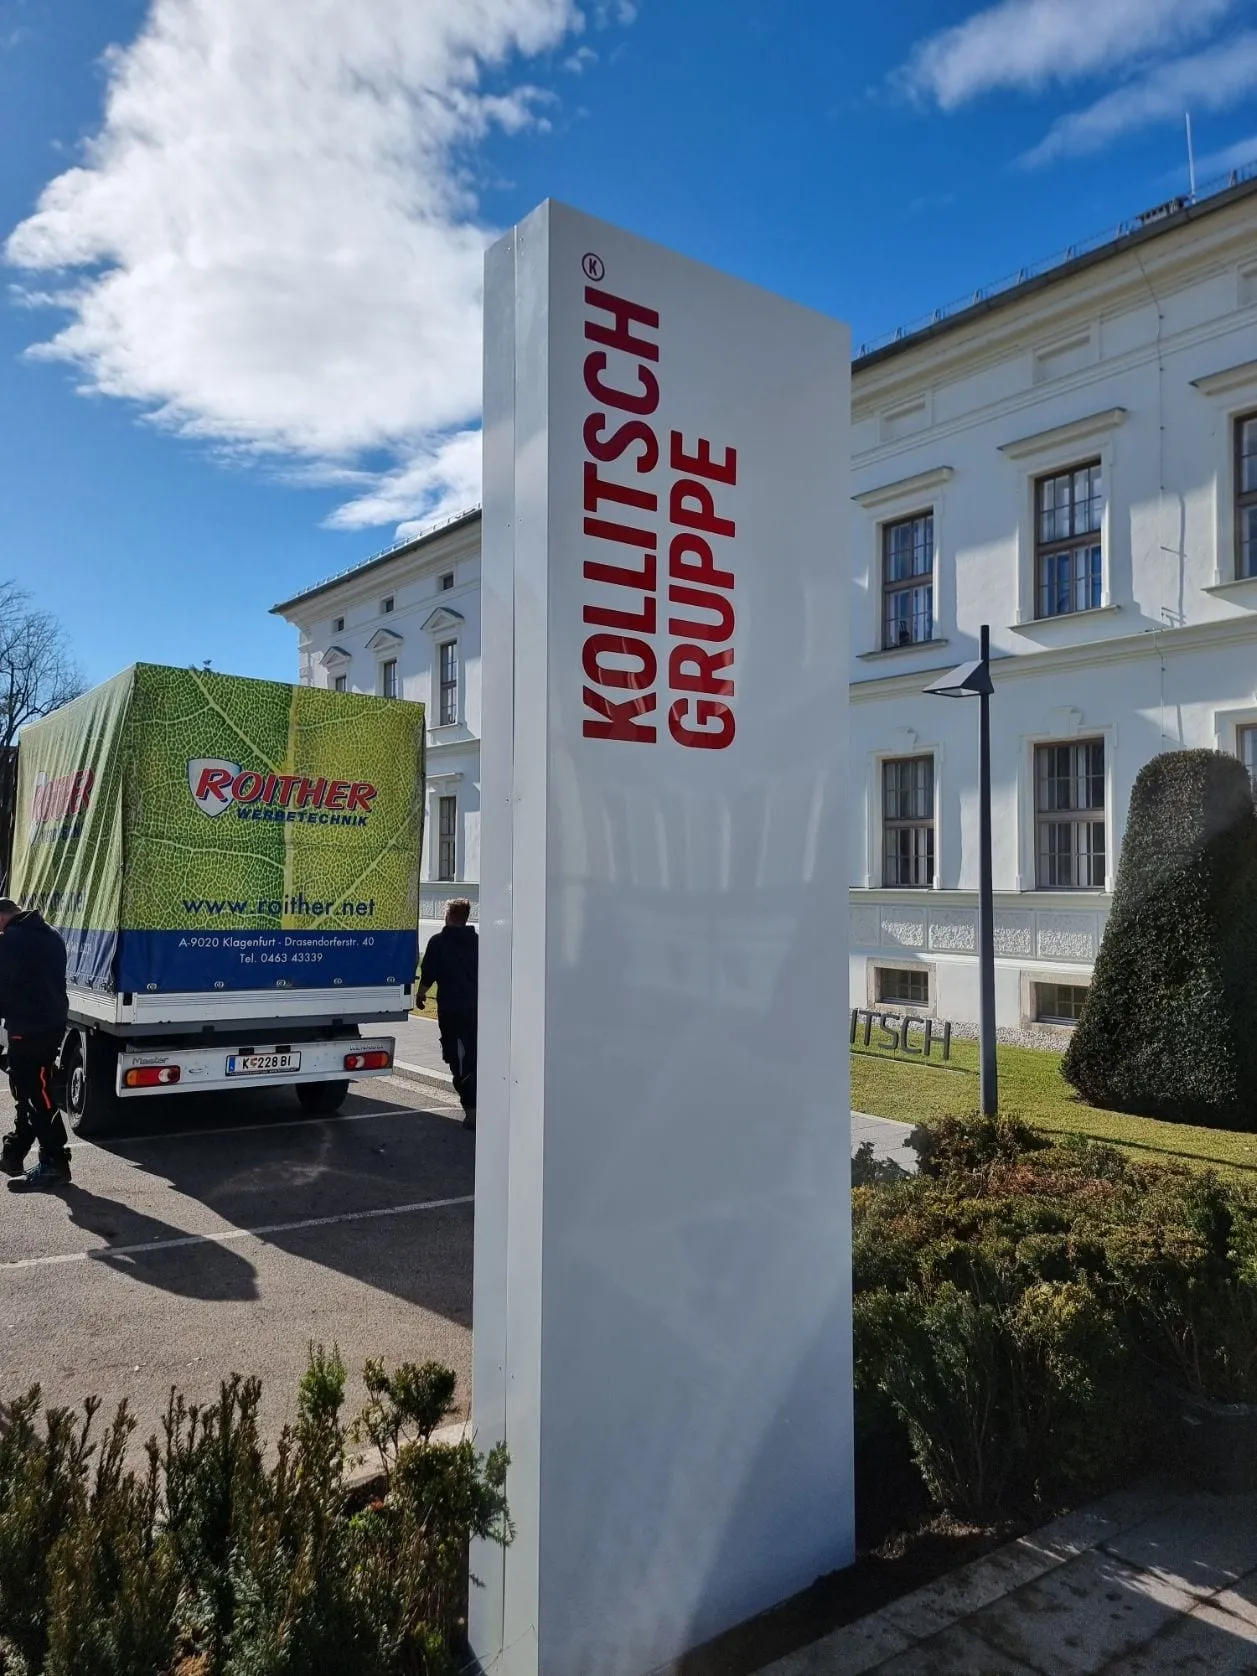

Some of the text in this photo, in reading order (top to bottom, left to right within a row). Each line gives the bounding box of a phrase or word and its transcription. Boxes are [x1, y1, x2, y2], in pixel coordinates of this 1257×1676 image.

[582, 285, 660, 744] KOLLITSCH
[668, 429, 738, 750] GRUPPE
[195, 767, 378, 813] ROITHER
[237, 807, 369, 827] WERBETECHNIK
[183, 892, 376, 917] www.roither.net
[178, 937, 220, 948] A-9020
[222, 936, 276, 950] Klagenfurt
[284, 936, 360, 947] Drasendorferstr.
[362, 936, 375, 947] 40
[240, 952, 323, 964] Tel. 0463 43339
